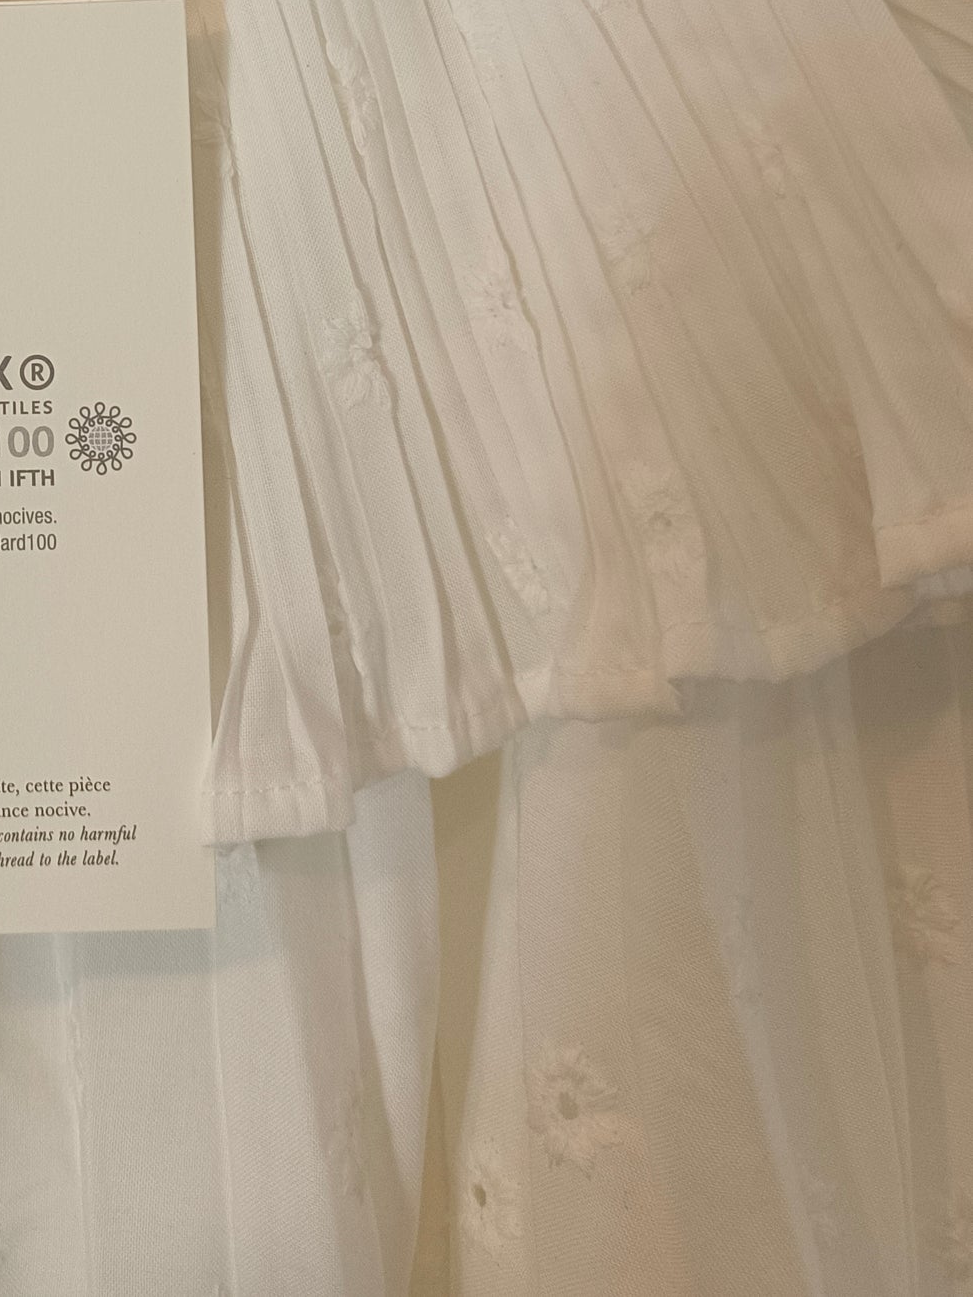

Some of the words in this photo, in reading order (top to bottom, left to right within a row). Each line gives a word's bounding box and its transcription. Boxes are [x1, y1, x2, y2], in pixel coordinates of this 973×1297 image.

[10, 468, 55, 488] IFTH
[24, 777, 65, 793] cette
[68, 777, 111, 797] pièce
[34, 802, 92, 818] nocive.
[58, 827, 76, 843] no
[79, 824, 137, 844] harmful
[39, 852, 52, 868] to
[57, 851, 77, 867] the
[81, 848, 120, 866] label.
